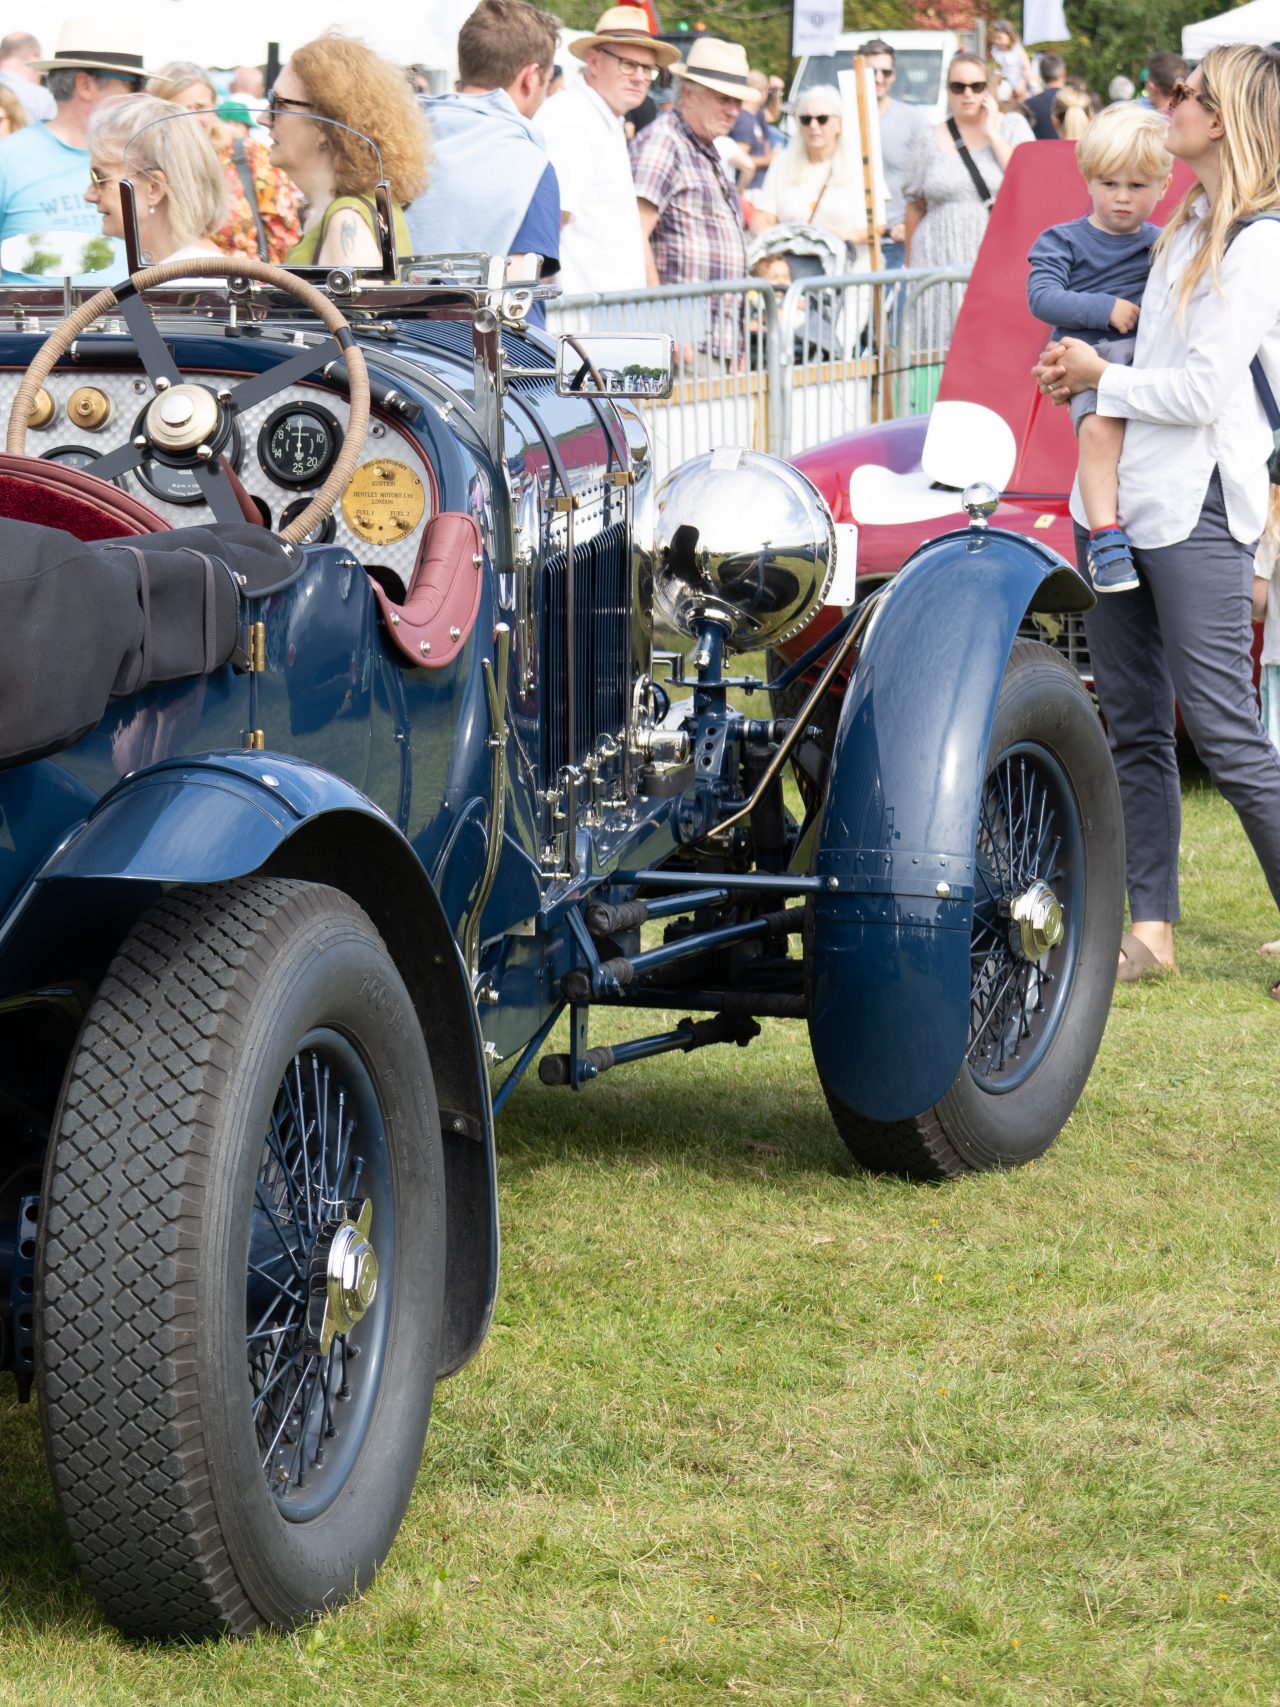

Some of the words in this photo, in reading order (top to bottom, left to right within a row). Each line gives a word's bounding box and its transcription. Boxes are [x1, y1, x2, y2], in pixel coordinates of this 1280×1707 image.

[277, 430, 284, 440] 8
[316, 433, 325, 444] 10
[274, 448, 282, 459] 14
[306, 456, 318, 467] 20
[292, 462, 304, 473] 25
